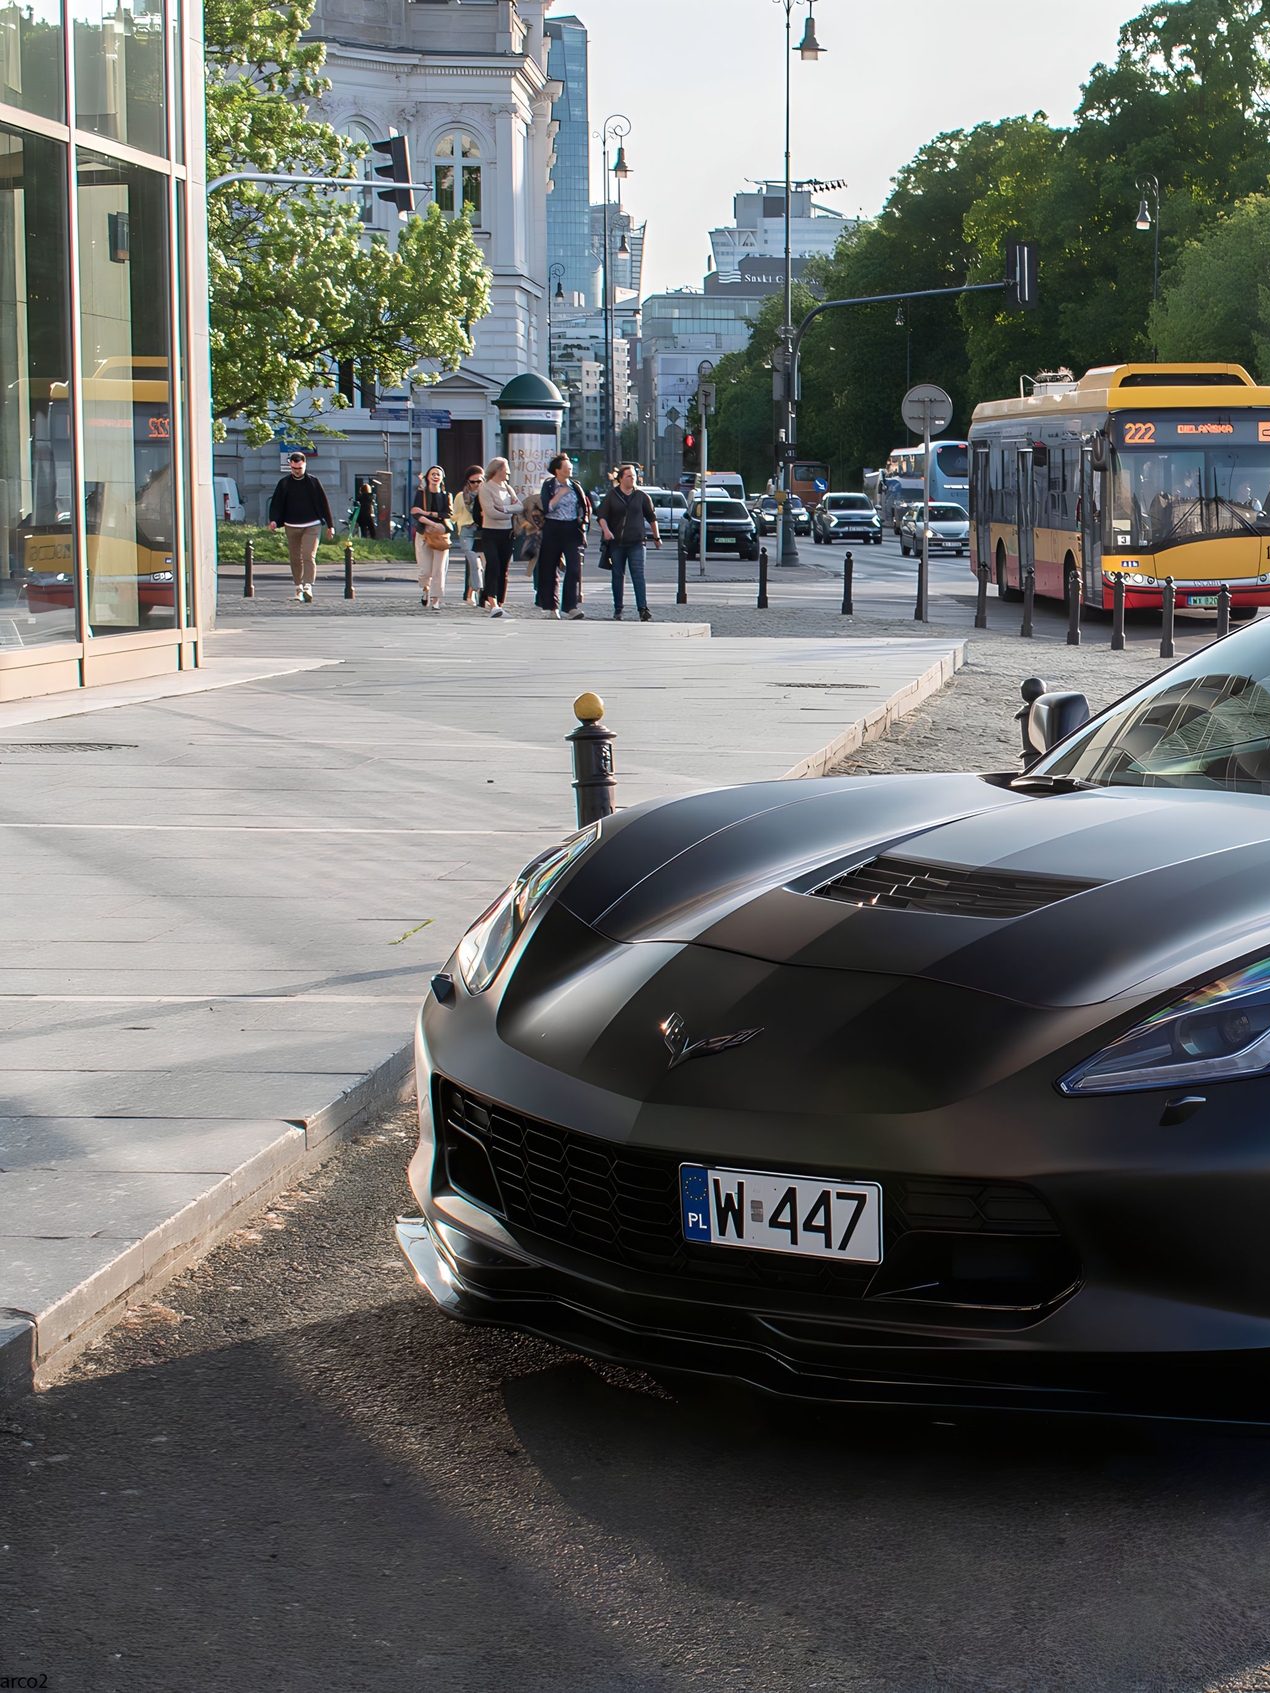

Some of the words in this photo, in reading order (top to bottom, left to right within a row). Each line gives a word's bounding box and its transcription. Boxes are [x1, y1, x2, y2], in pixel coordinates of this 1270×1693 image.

[1124, 422, 1157, 444] 222
[687, 1212, 708, 1230] PL
[713, 1177, 745, 1239] W
[768, 1185, 868, 1251] 447
